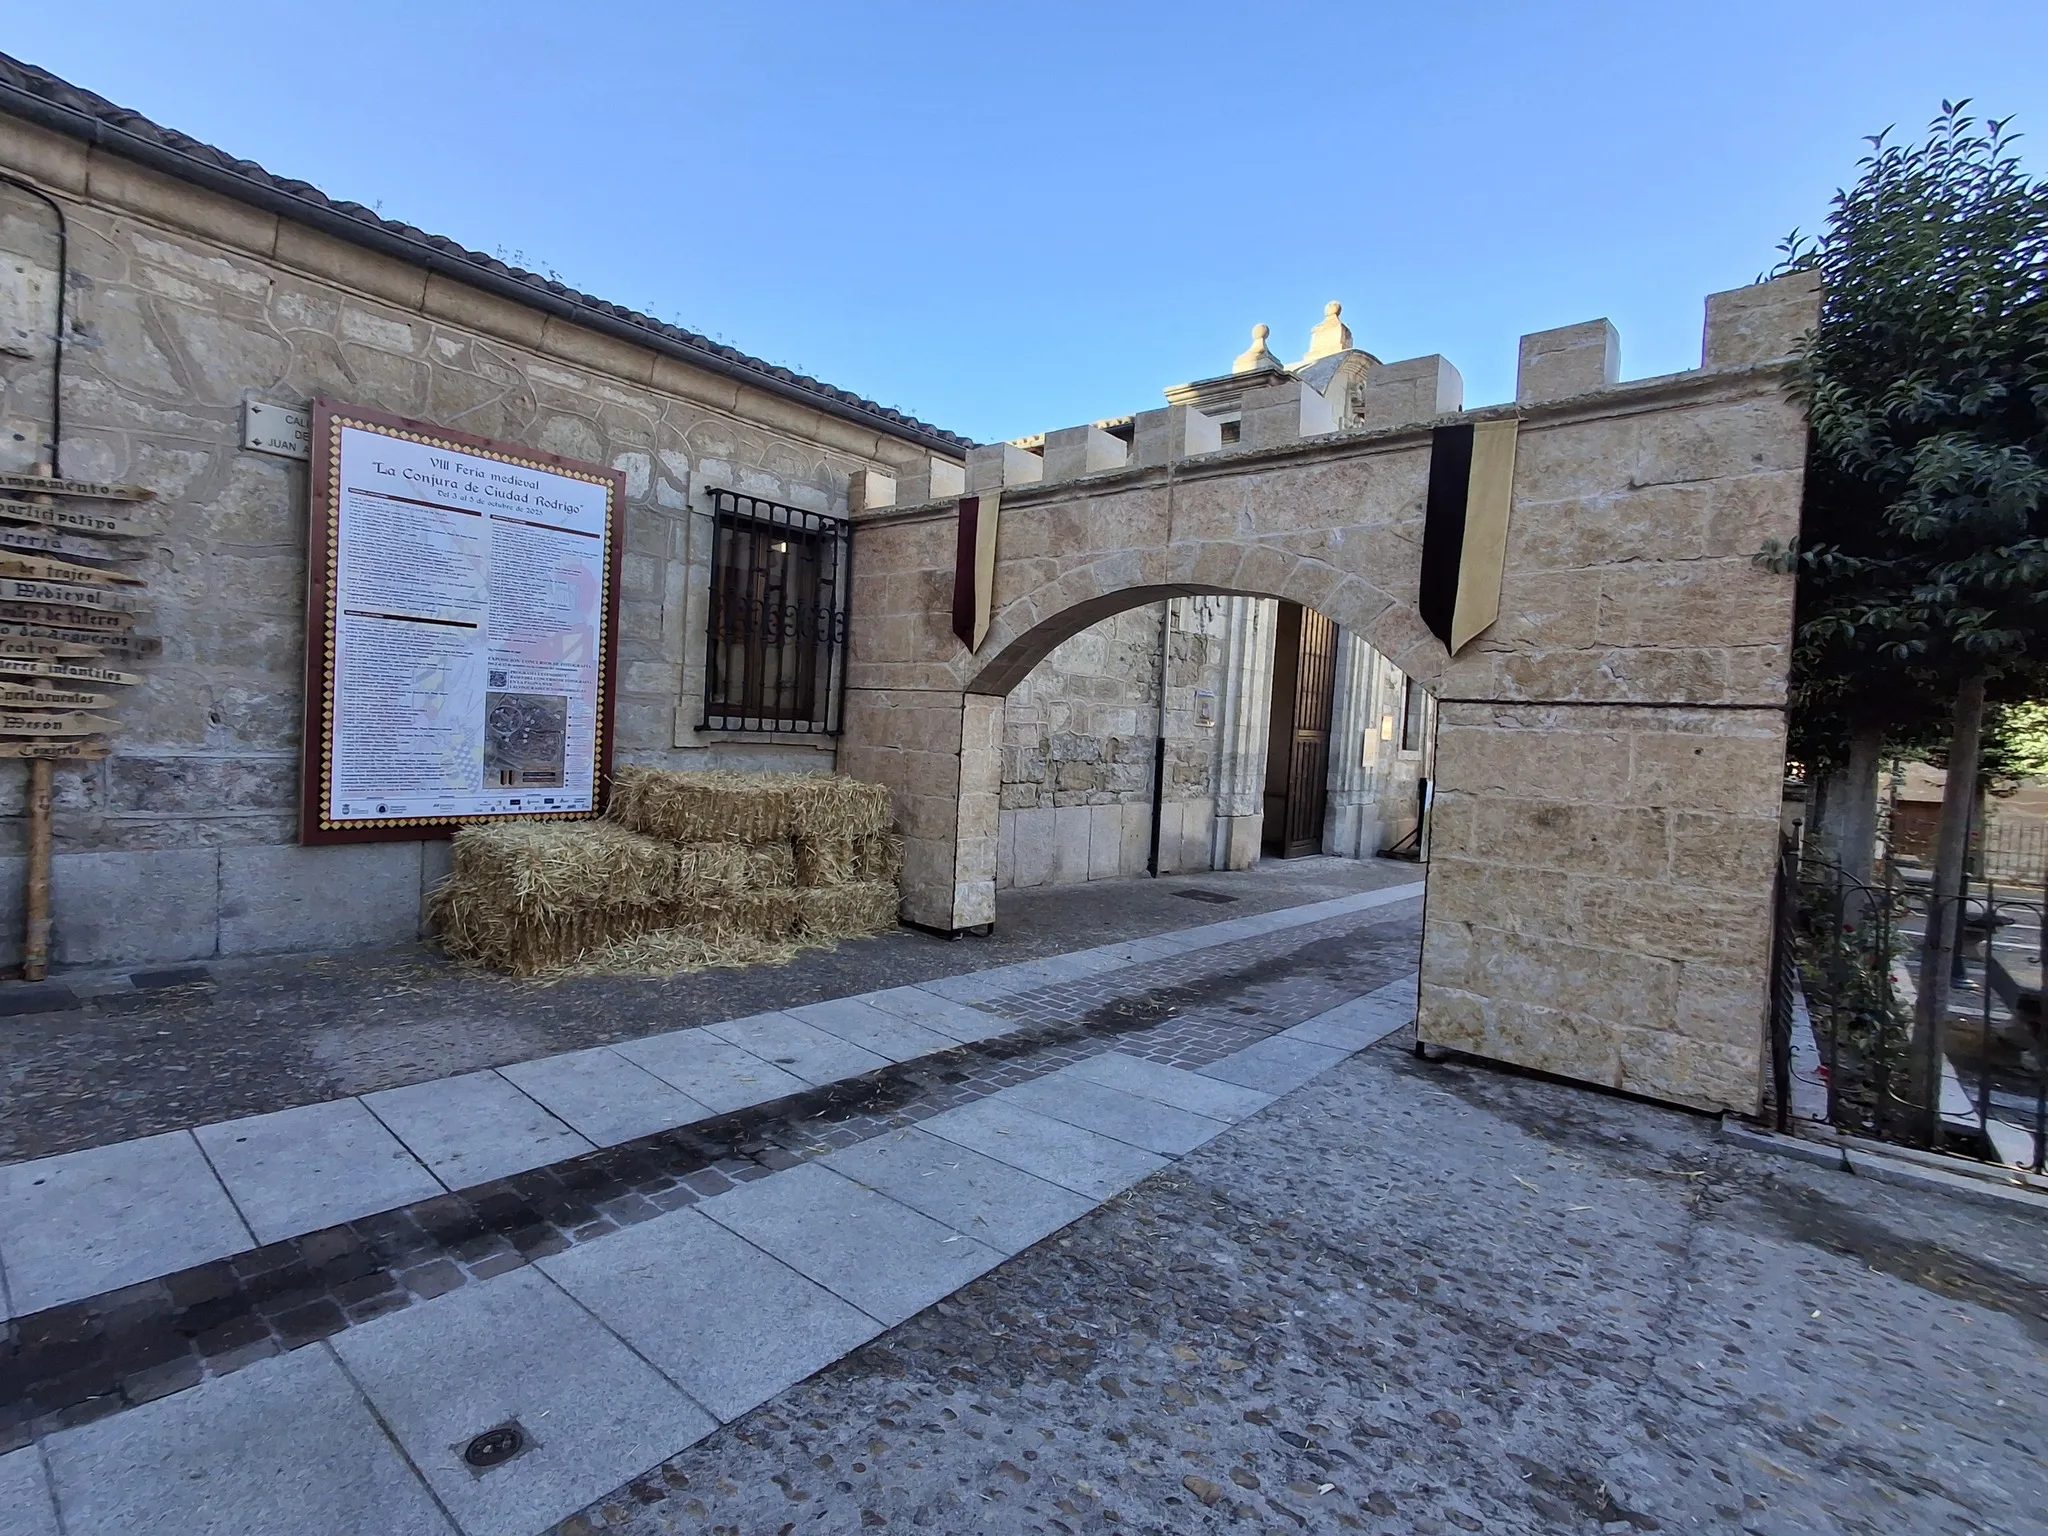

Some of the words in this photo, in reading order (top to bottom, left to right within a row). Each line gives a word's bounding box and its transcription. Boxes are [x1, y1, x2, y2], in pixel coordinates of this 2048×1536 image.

[268, 438, 296, 451] JUAN
[430, 457, 449, 470] VIII
[455, 462, 485, 478] Feria
[490, 473, 539, 490] medieval
[0, 476, 110, 494] mpamento
[402, 468, 458, 489] Conjura
[464, 481, 479, 493] de
[484, 485, 528, 503] Ciudad
[437, 489, 449, 498] Del
[460, 494, 467, 502] al
[487, 500, 514, 511] octubre
[15, 582, 101, 604] Medieval
[0, 685, 95, 704] uentacuentos
